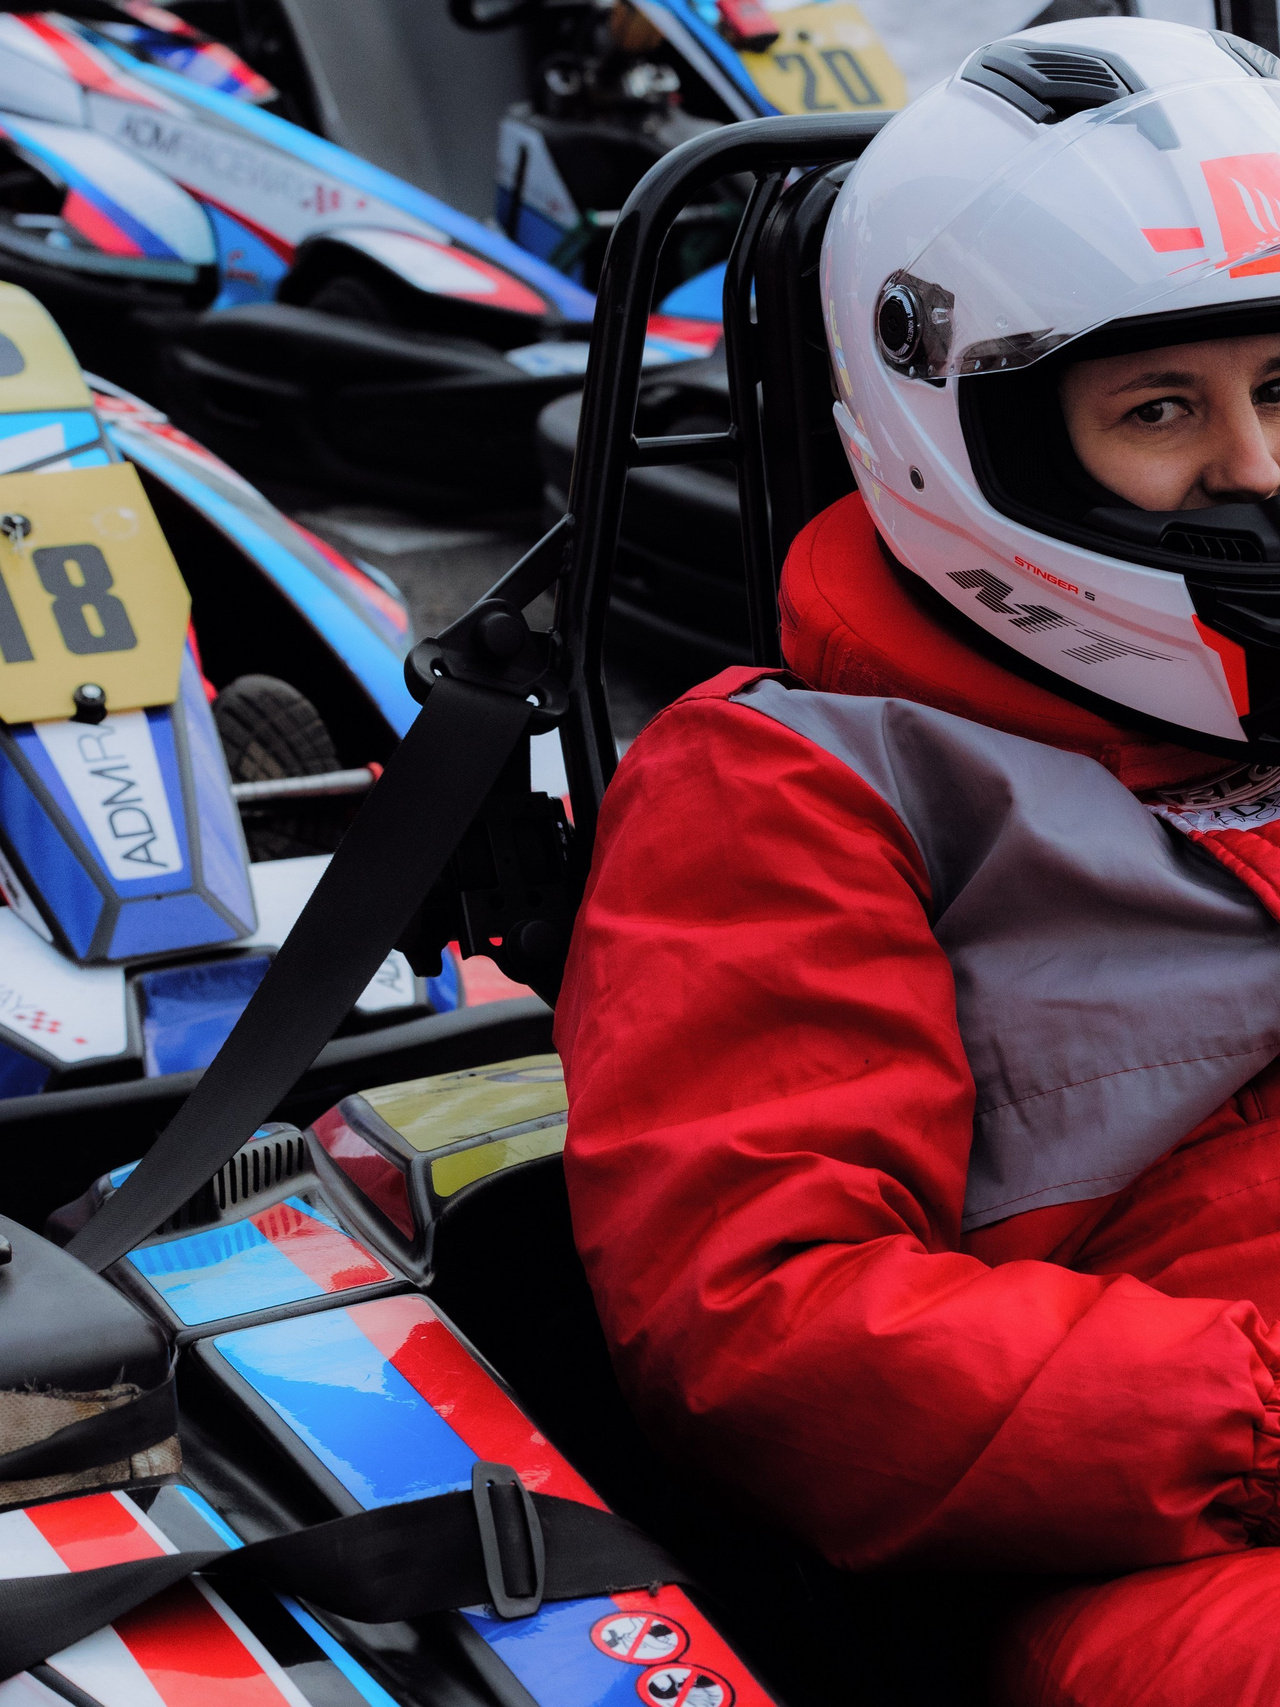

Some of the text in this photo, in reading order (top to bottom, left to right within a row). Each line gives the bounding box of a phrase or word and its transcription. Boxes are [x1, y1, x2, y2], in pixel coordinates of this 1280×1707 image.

[774, 48, 881, 110] 20
[1014, 555, 1096, 602] STINGER S
